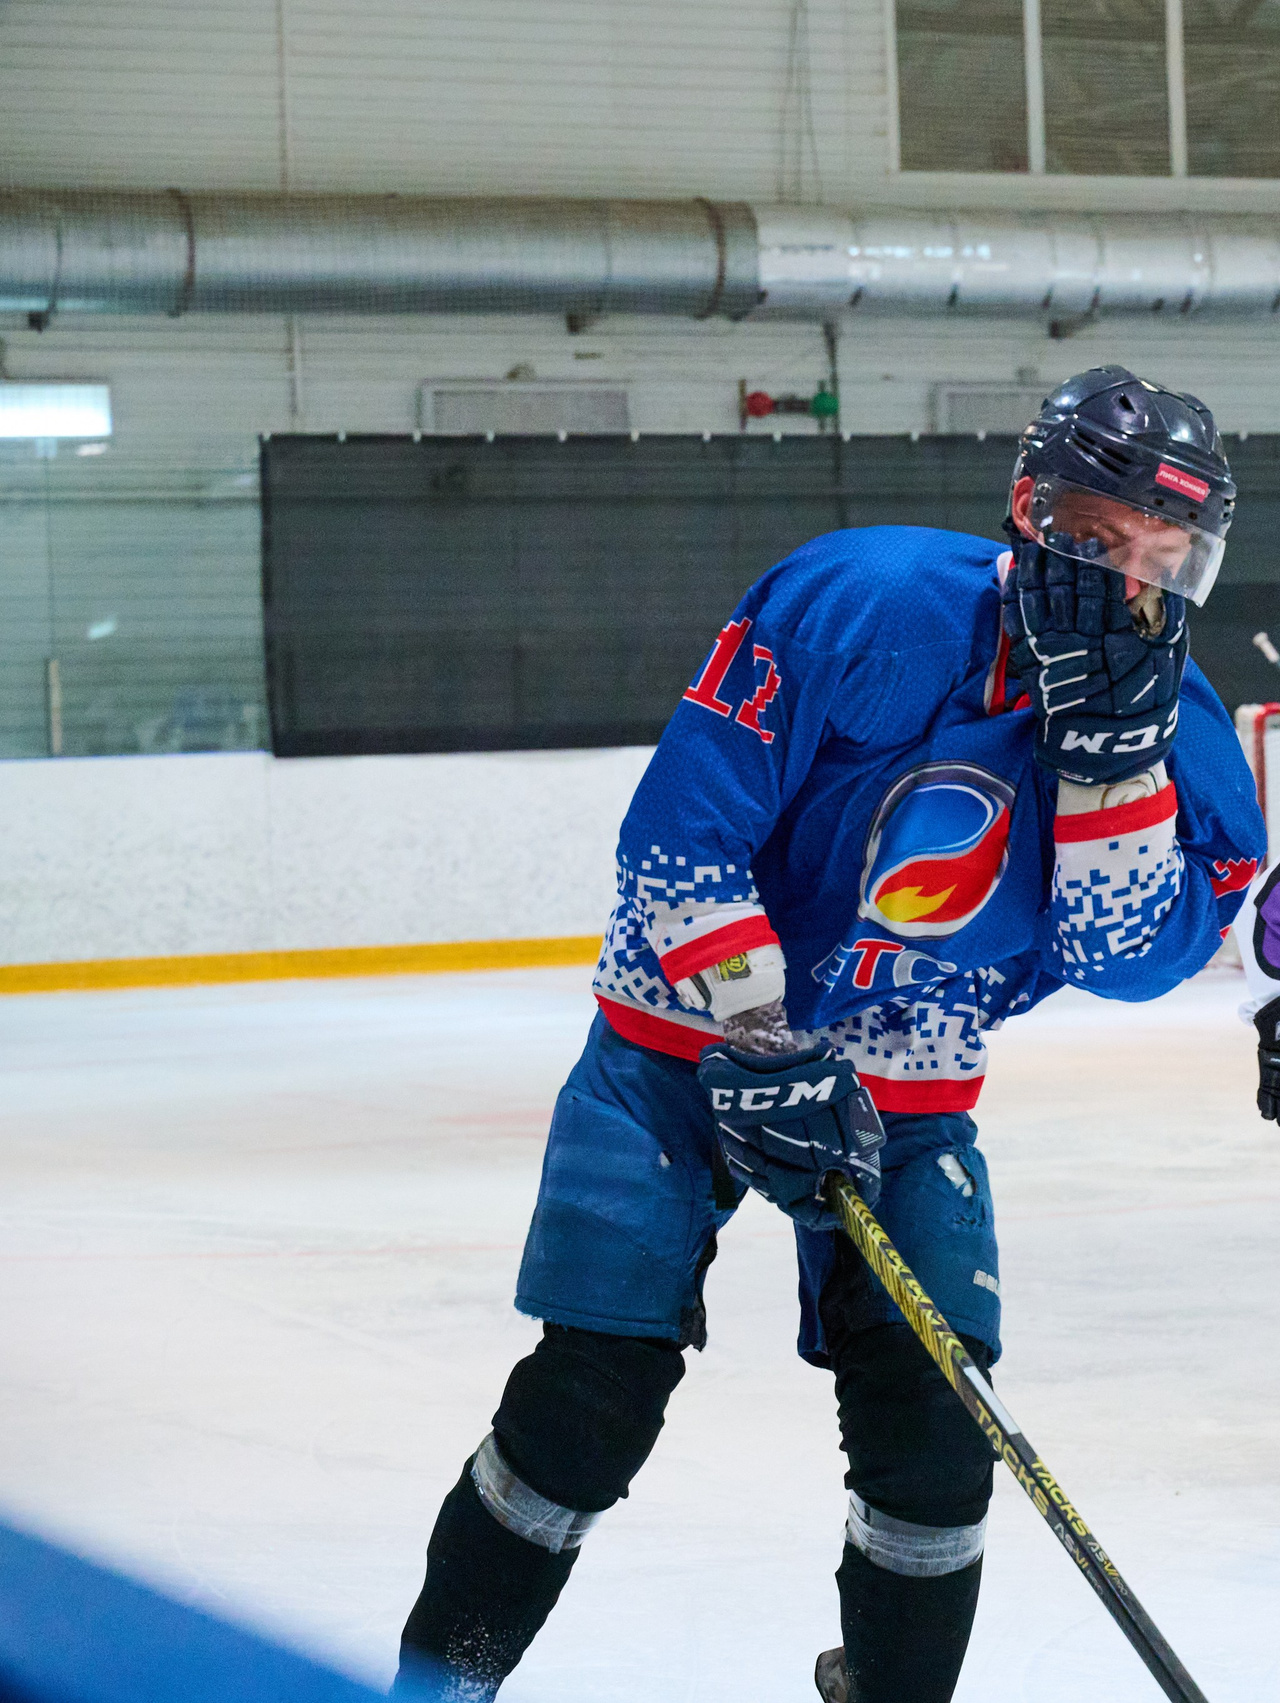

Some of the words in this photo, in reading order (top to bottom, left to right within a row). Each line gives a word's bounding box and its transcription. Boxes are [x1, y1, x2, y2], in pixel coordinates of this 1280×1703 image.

[711, 1075, 837, 1111] CCM
[976, 1399, 1050, 1516] TACKS
[1031, 1455, 1091, 1537] TACKS
